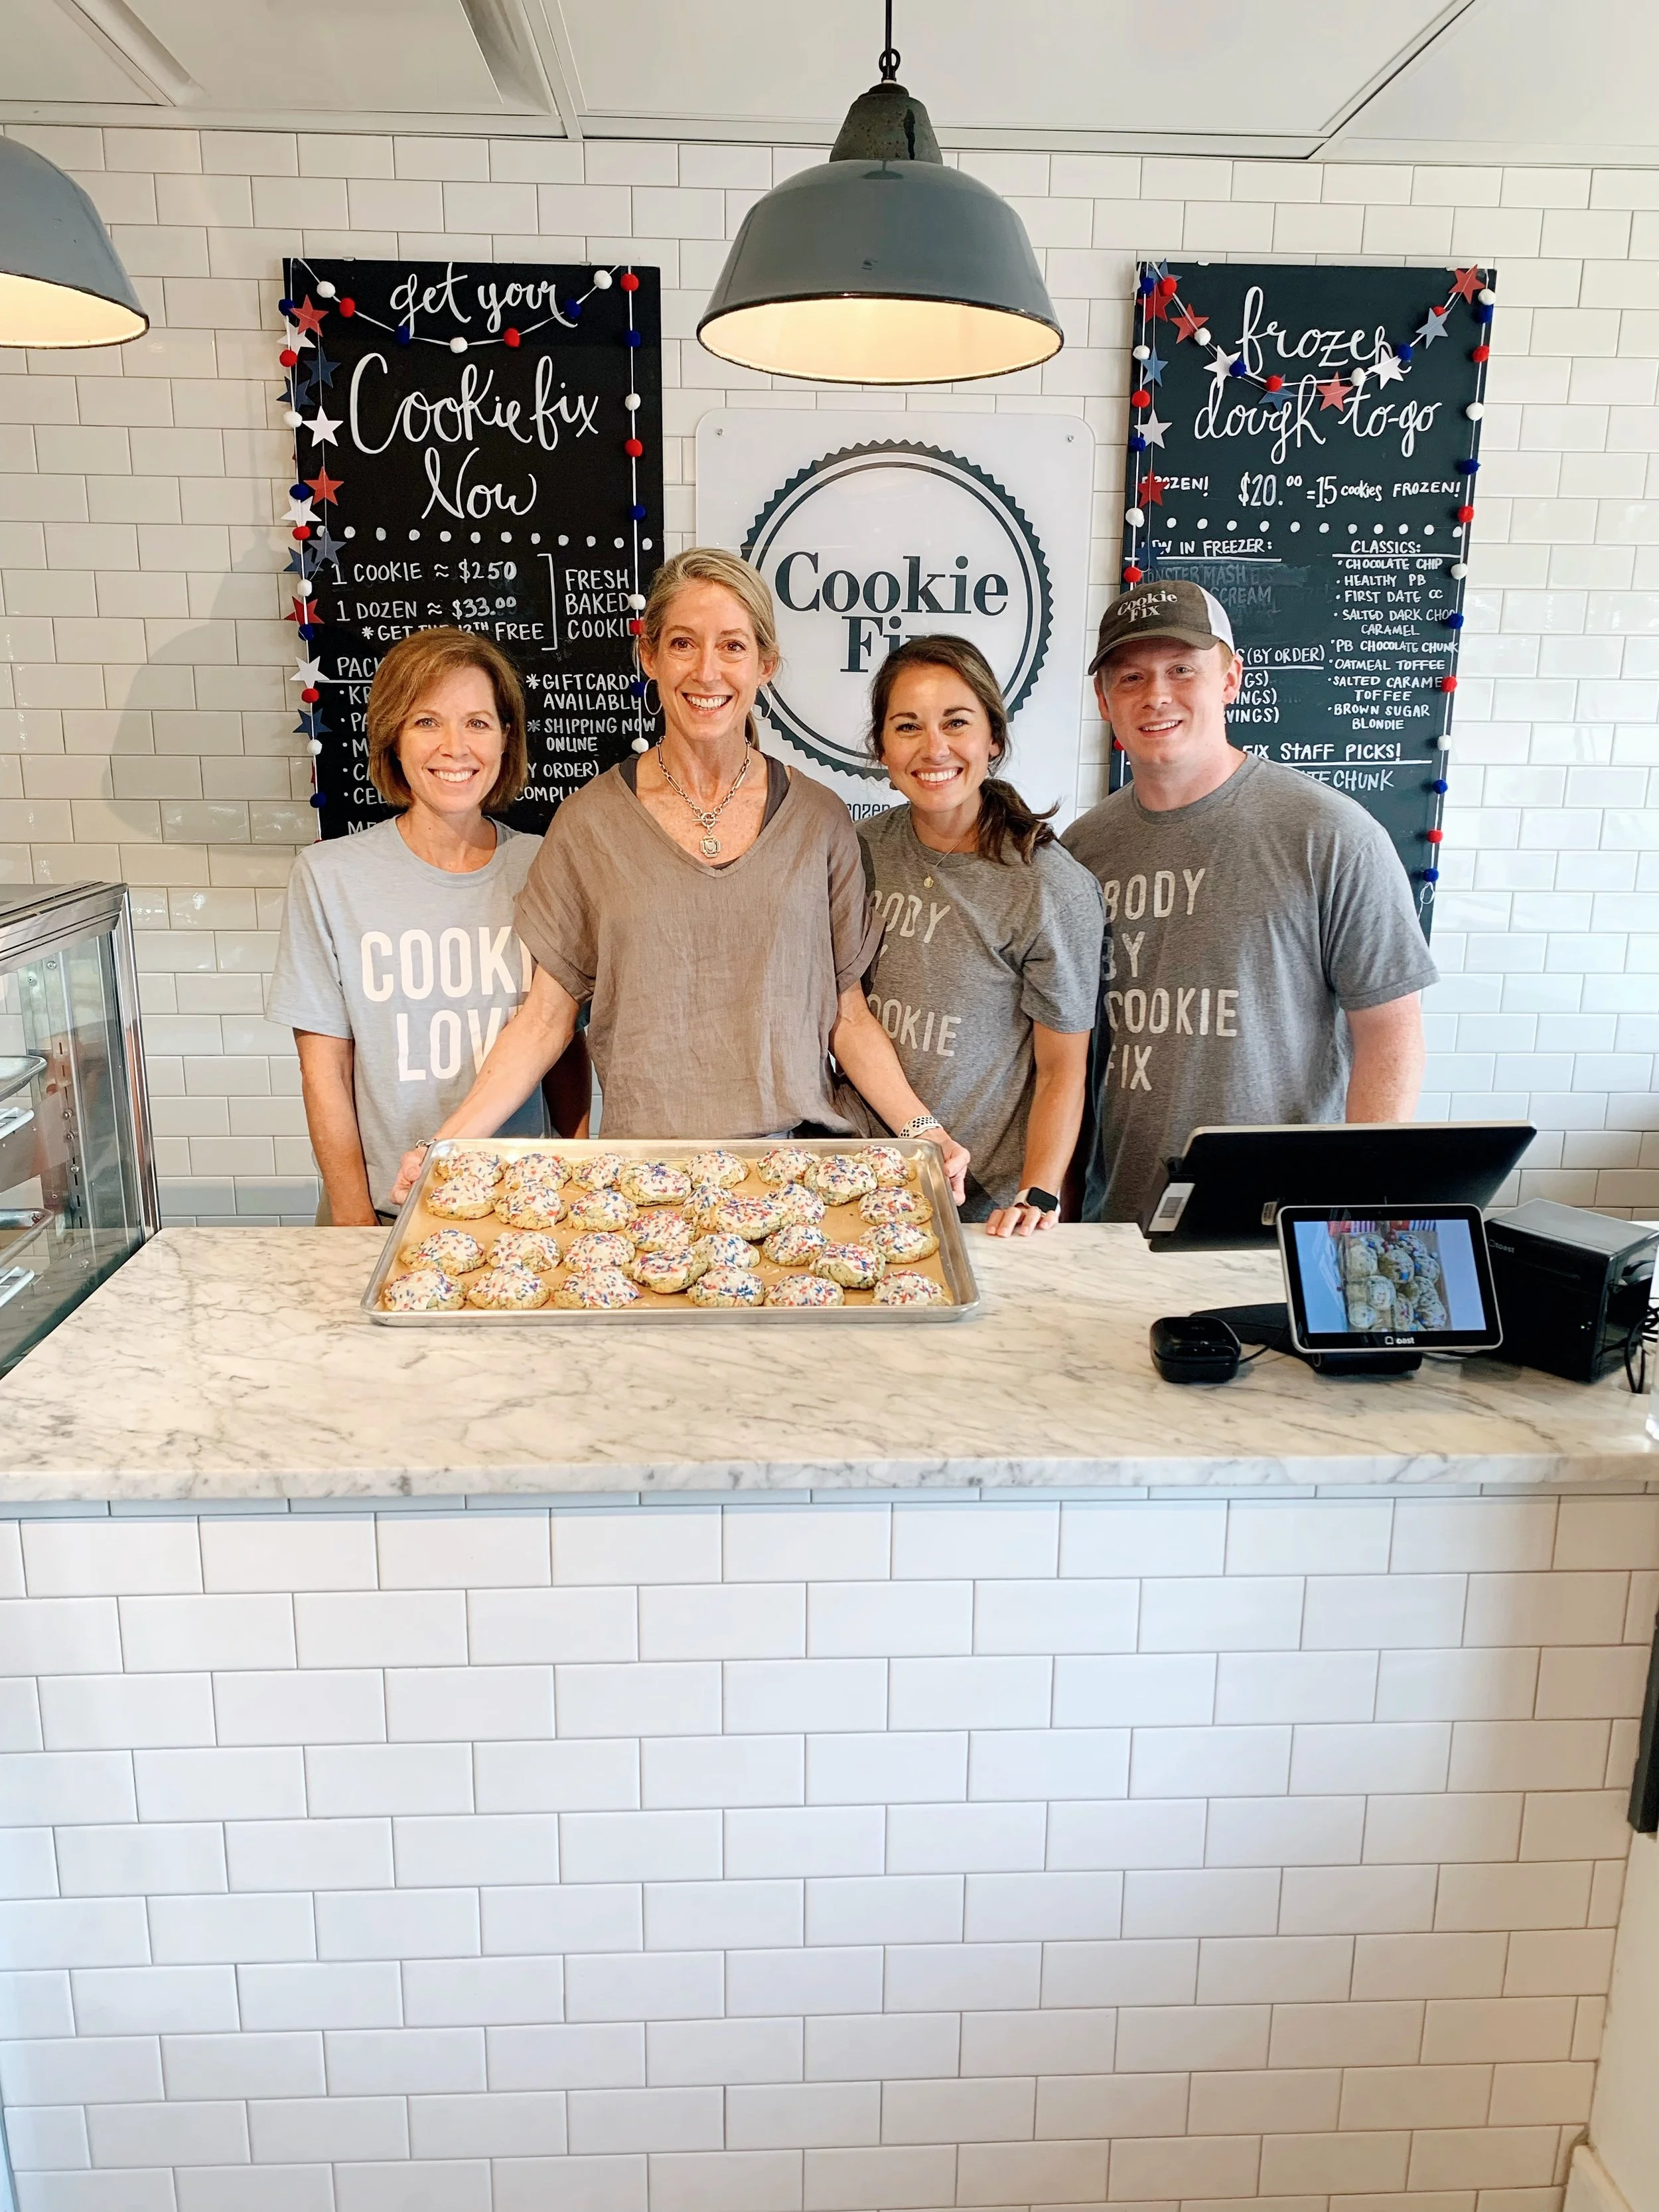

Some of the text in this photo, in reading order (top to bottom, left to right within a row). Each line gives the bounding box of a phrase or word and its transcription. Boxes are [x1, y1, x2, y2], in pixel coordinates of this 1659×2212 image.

[390, 261, 578, 339] get your
[1236, 285, 1412, 376] frozen
[1194, 374, 1443, 465] dough to-go
[421, 447, 537, 519] Now
[1340, 480, 1383, 502] cookies
[1392, 481, 1461, 498] FROZEN!
[1180, 540, 1195, 555] IN
[1203, 538, 1273, 557] FREEZER:
[1350, 540, 1421, 554] CLASSICS:
[331, 563, 348, 585] 1
[354, 561, 423, 581] COOKIE
[1344, 558, 1443, 570] CHOCOLATE CHIP
[565, 569, 630, 591] FRESH
[775, 552, 1009, 616] Cookie
[1344, 573, 1426, 587] HEALTHY PB
[565, 593, 630, 615] BAKED
[1117, 590, 1178, 616] Cookie
[1344, 589, 1443, 604] FIRST DATE CC
[336, 600, 350, 622] 1
[356, 601, 417, 619] DOZEN
[1128, 605, 1161, 623] Fix
[1342, 609, 1384, 621] SALTED
[1389, 609, 1423, 621] DARK
[496, 622, 544, 641] FREE
[1360, 623, 1420, 636] CARAMEL
[840, 615, 926, 673] Fi
[1336, 639, 1460, 654] PB CHOCOLATE CHUNK
[1274, 644, 1325, 664] ORDER)
[1334, 658, 1445, 671] OATMEAL TOFFEE
[1333, 676, 1443, 689] SALTED CARAME
[1354, 690, 1413, 701] TOFFEE
[1334, 703, 1431, 717] BROWN SUGAR
[622, 717, 656, 735] NOW
[1352, 717, 1405, 730] BLONDIE
[546, 736, 598, 753] ONLINE
[1280, 743, 1334, 761] STAFF
[1346, 743, 1401, 761] PICKS!
[543, 760, 599, 778] ORDER)
[1333, 769, 1395, 791] CHUNK
[1103, 868, 1206, 923] BODY
[1101, 931, 1145, 981] BY
[1104, 988, 1239, 1037] COOKIE
[396, 1005, 523, 1082] LOV
